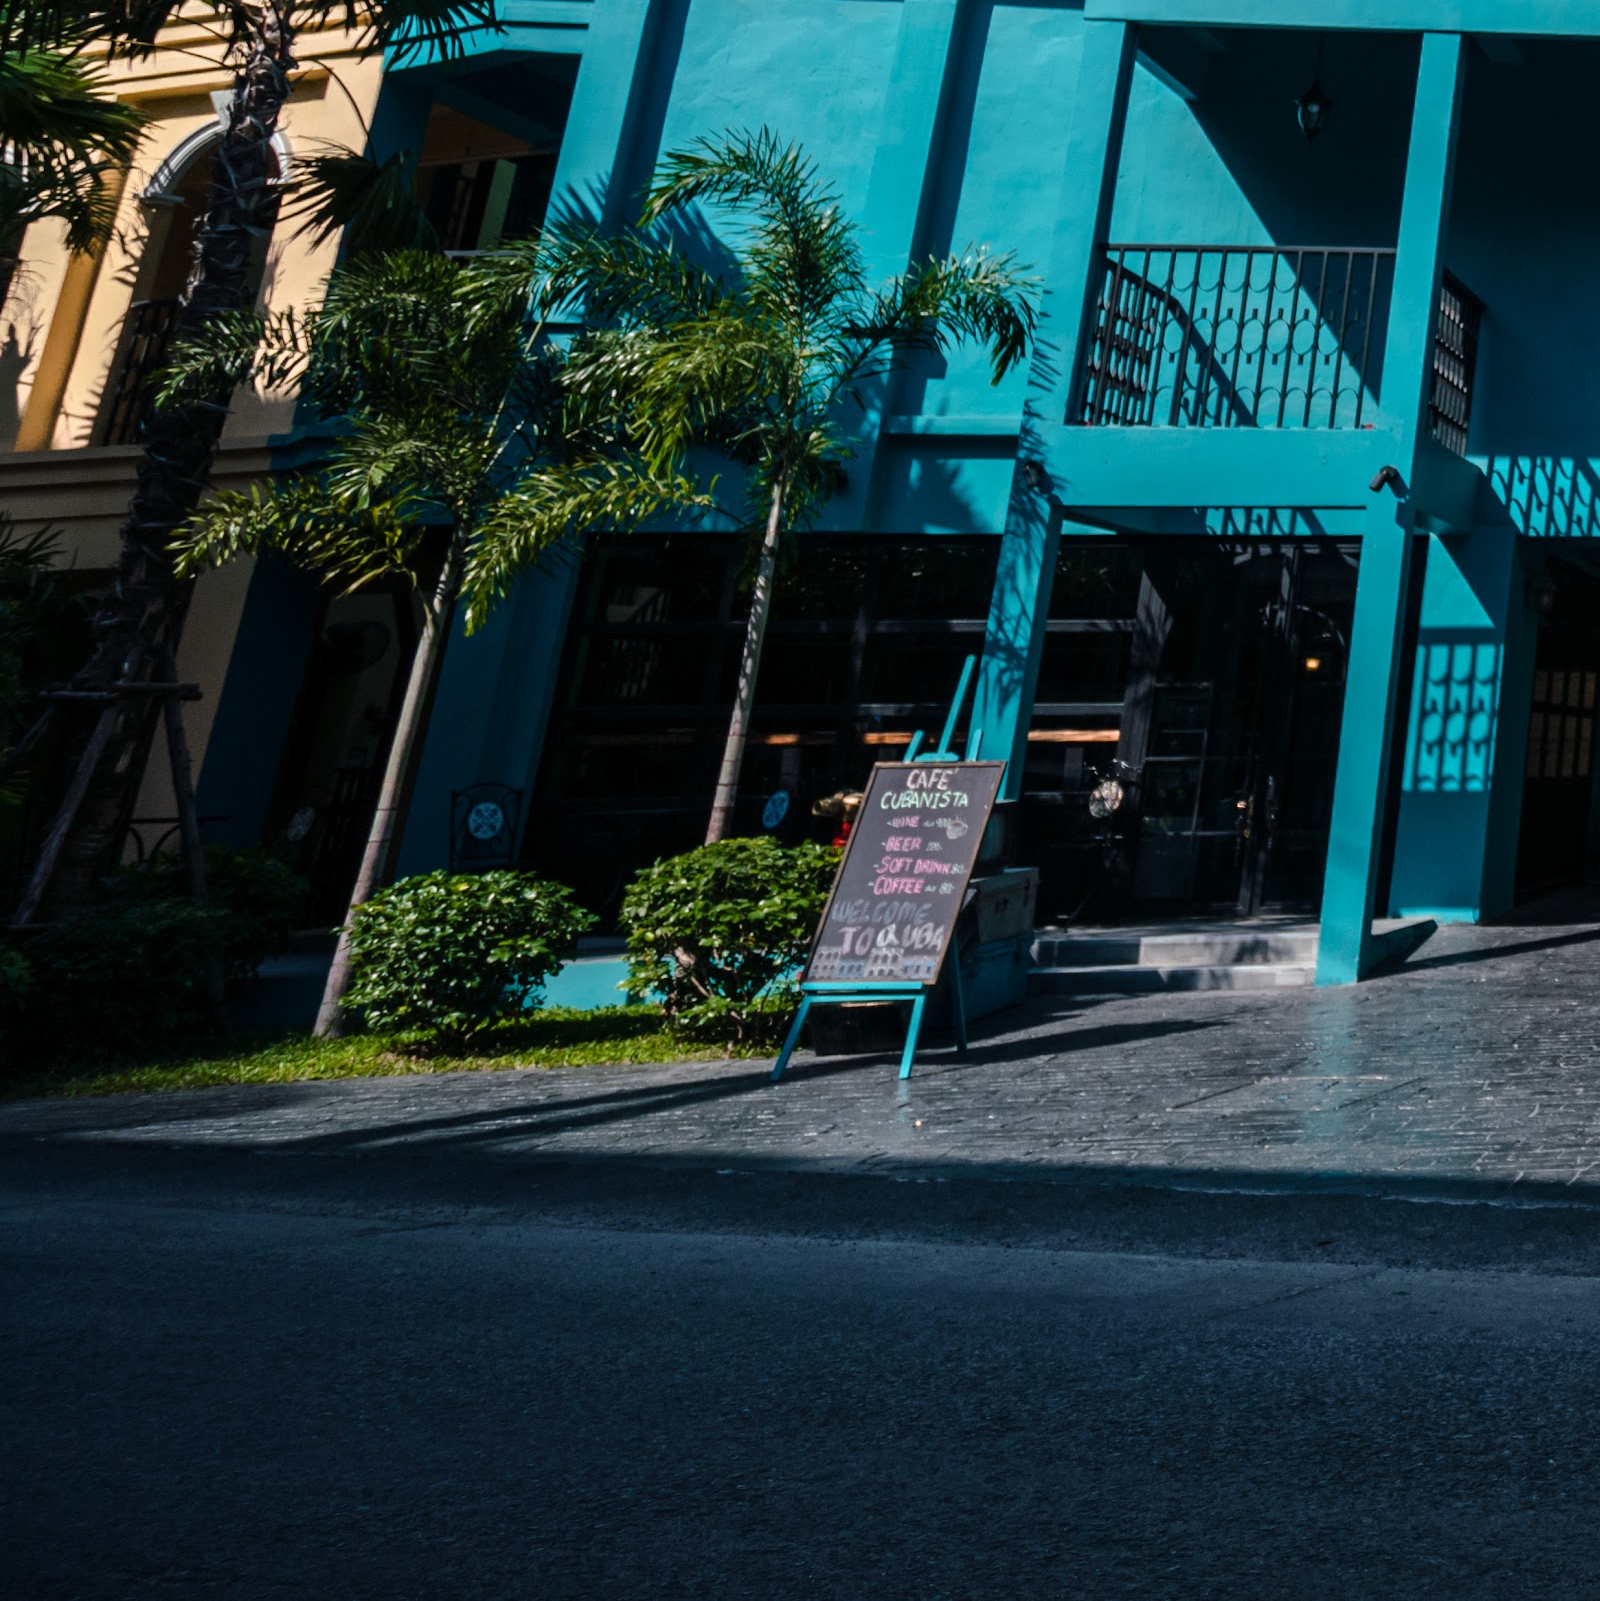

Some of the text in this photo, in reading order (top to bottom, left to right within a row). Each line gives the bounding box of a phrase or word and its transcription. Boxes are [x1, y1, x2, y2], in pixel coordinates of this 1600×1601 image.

[880, 790, 970, 810] CUBANISTA
[885, 835, 922, 852] BEER
[876, 855, 913, 874] SOFT
[913, 858, 952, 875] DRINK
[873, 874, 925, 896] COFFEE
[831, 898, 933, 925] WELCOME
[838, 925, 875, 956] TO
